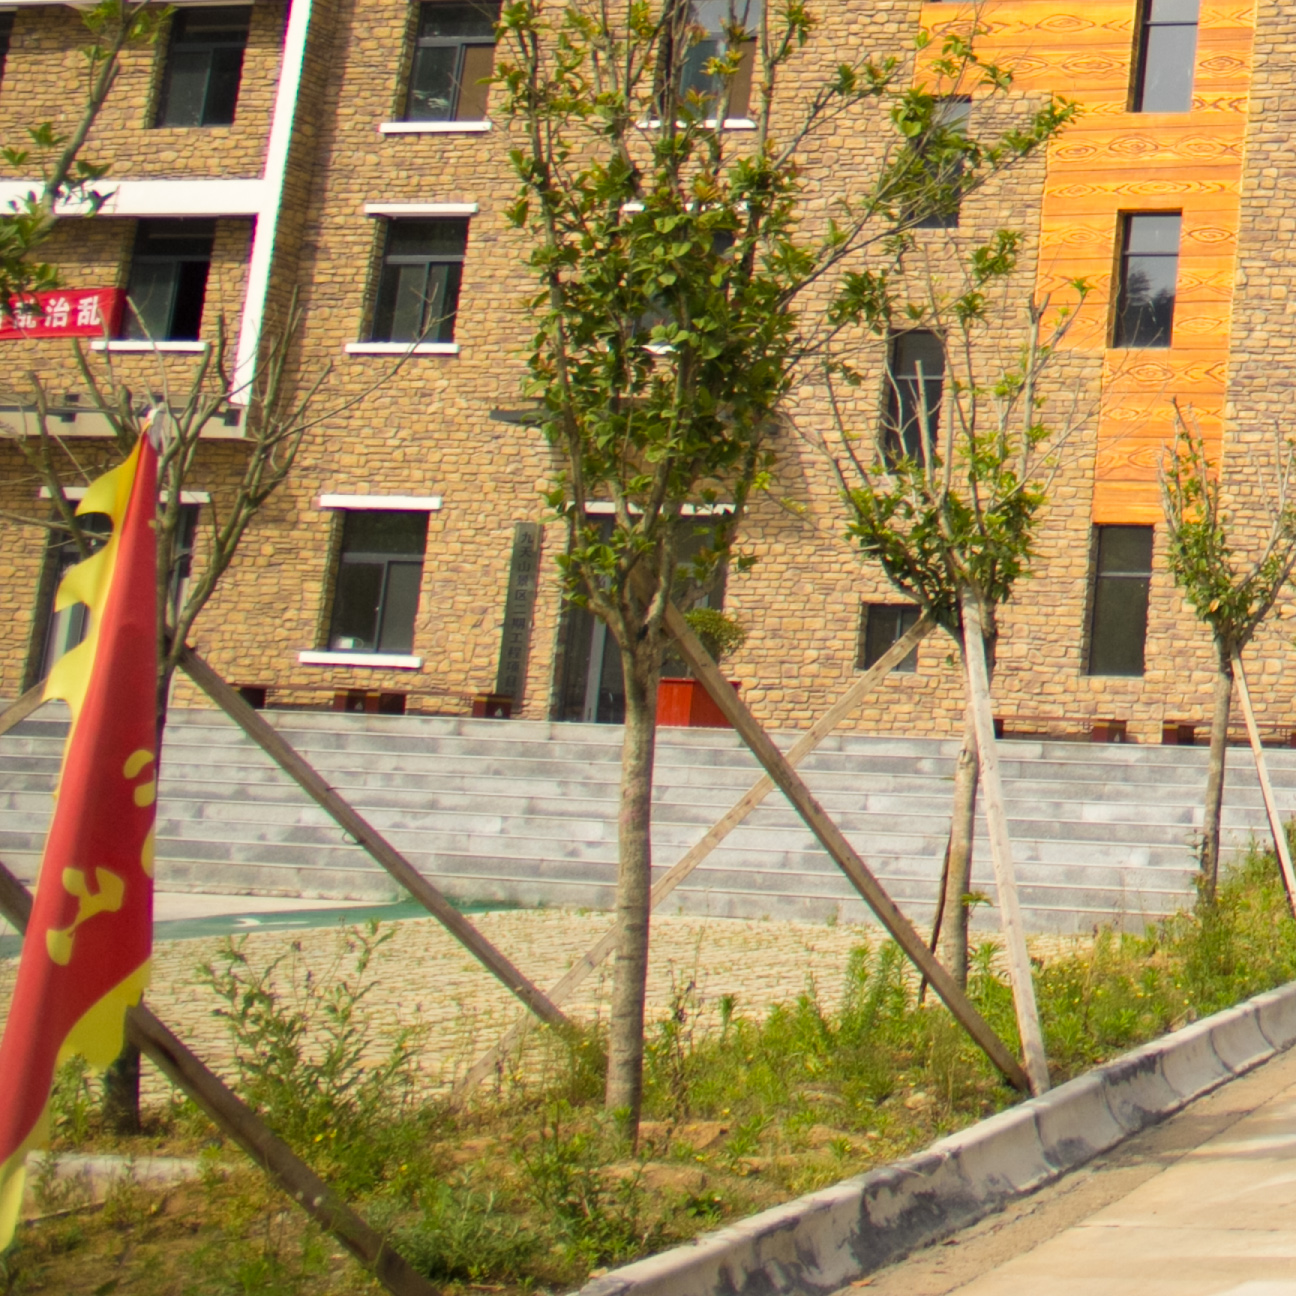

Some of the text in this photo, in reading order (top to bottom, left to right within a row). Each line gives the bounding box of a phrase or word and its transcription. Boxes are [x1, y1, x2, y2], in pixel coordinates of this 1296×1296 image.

[506, 531, 533, 696] 九天山景区二期工程项目
